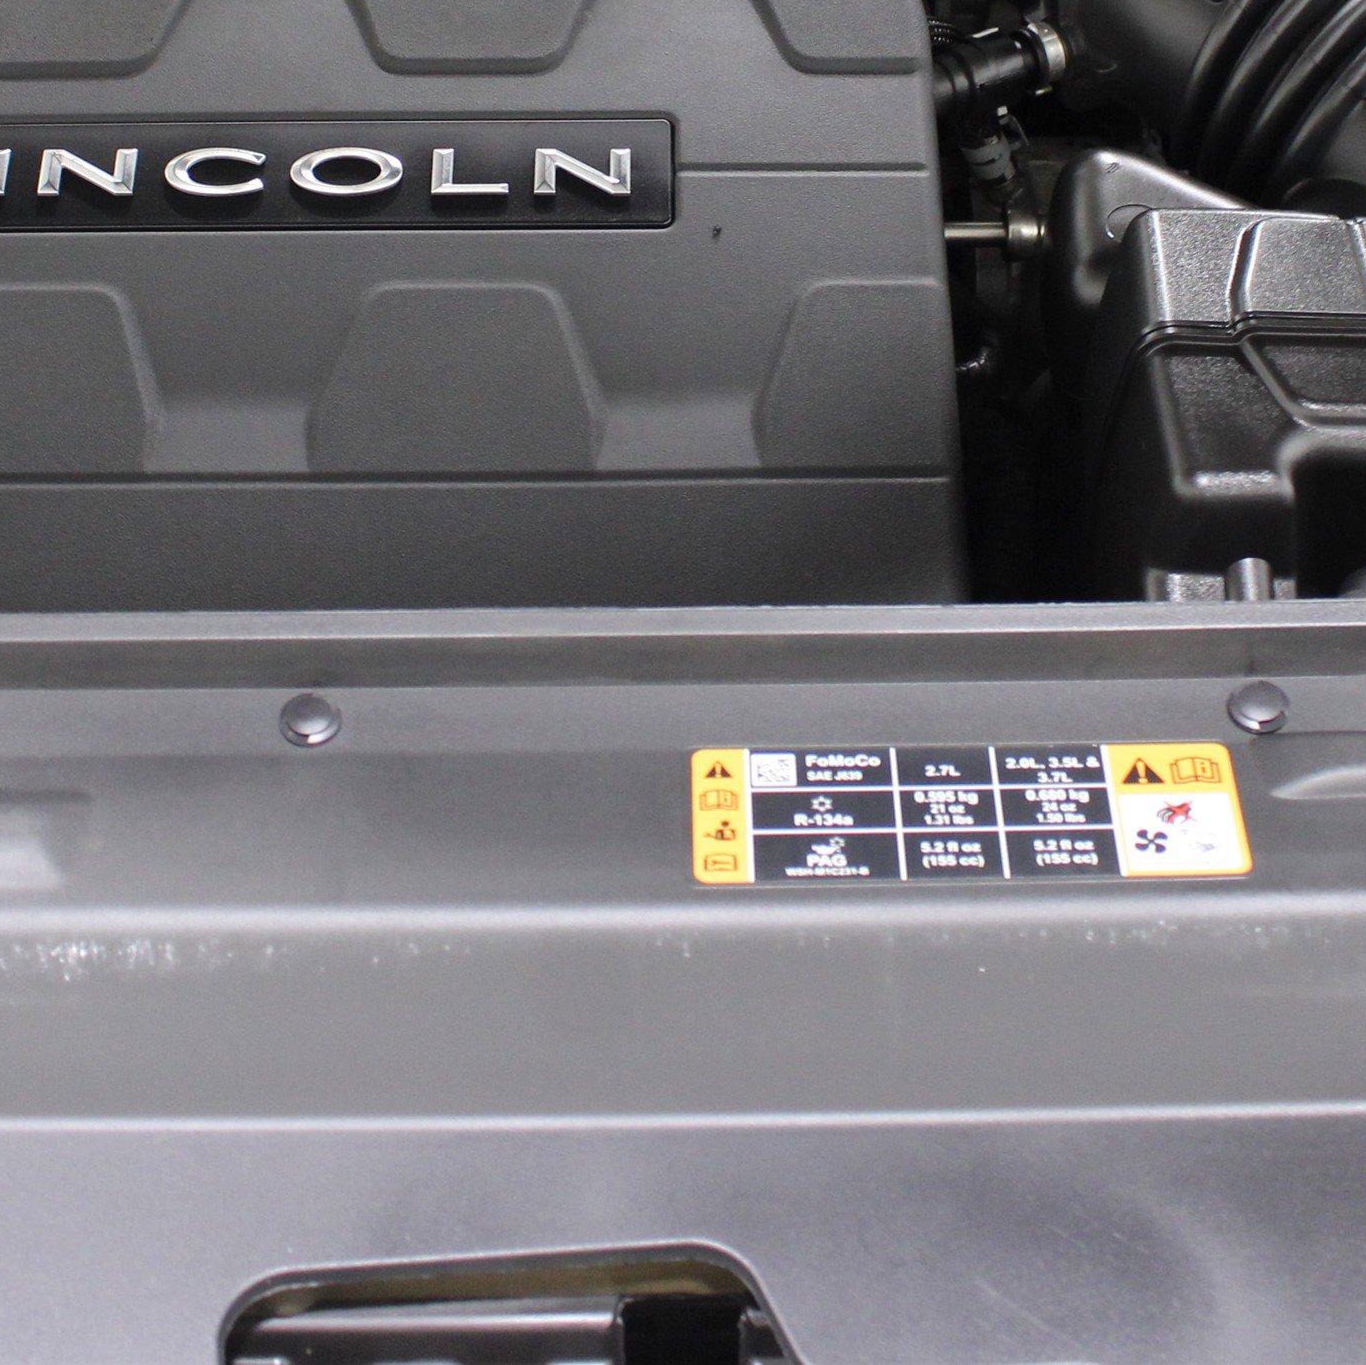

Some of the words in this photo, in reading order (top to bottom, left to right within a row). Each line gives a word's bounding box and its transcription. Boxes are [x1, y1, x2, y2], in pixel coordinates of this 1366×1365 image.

[805, 754, 881, 768] FoMoCo
[1048, 756, 1084, 769] 3.5L
[1085, 756, 1101, 768] &
[806, 771, 832, 782] SAE
[925, 764, 961, 778] 2.7L
[1037, 771, 1074, 784] 3.7L
[958, 791, 979, 806] kg
[1068, 789, 1090, 804] kg
[929, 804, 946, 815] 21
[947, 805, 966, 815] oz
[1059, 802, 1077, 812] oz
[793, 813, 854, 827] R-134a
[923, 814, 950, 826] 1.31
[952, 814, 975, 826] lbs
[1064, 812, 1087, 824] lbs
[920, 840, 945, 854] 5.2
[961, 842, 982, 853] oz
[1033, 839, 1058, 852] 5.2
[1073, 840, 1095, 851] oz
[805, 853, 848, 867] PAG
[922, 854, 957, 870] (155
[958, 853, 986, 869] cc)
[1035, 853, 1071, 867] (155
[1072, 852, 1099, 866] cc)
